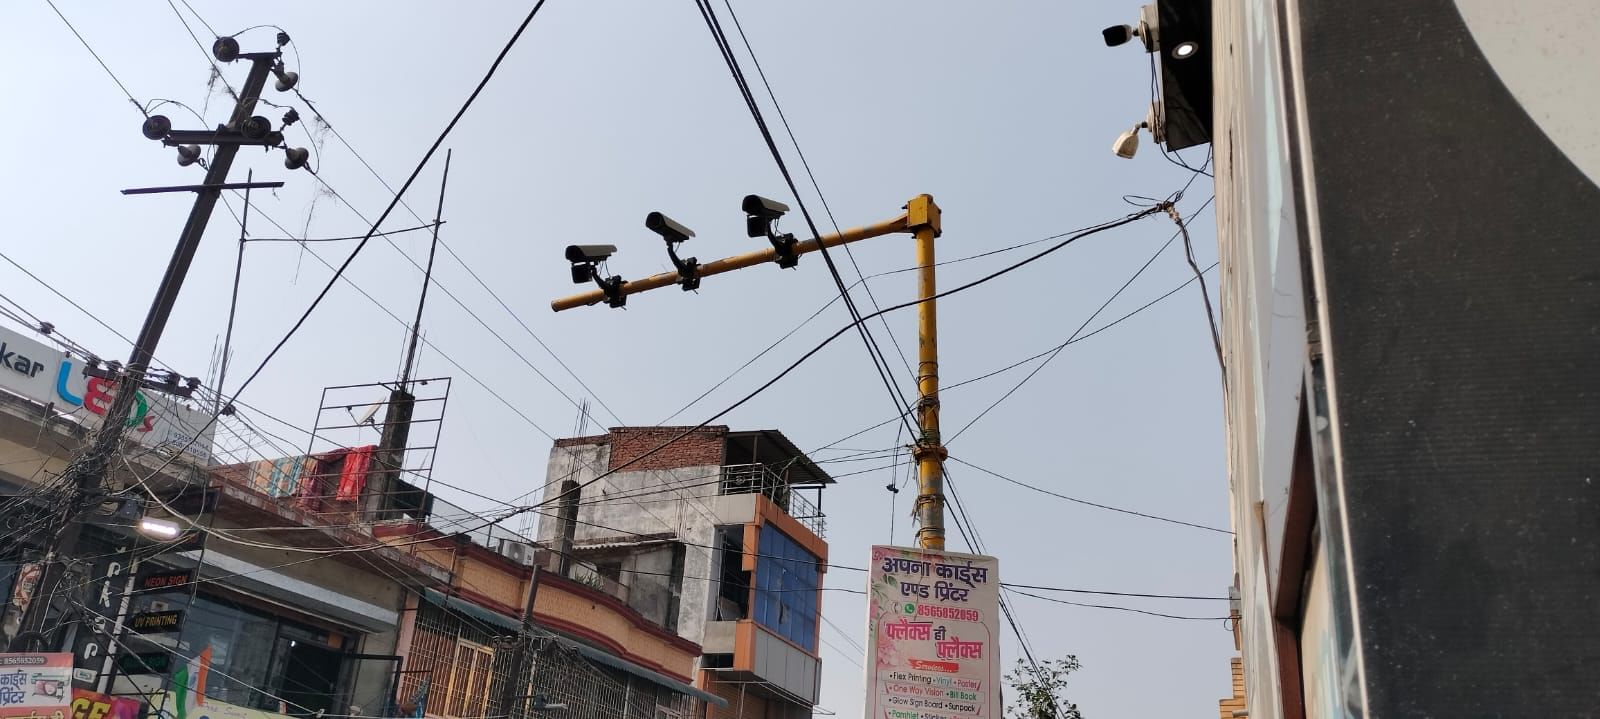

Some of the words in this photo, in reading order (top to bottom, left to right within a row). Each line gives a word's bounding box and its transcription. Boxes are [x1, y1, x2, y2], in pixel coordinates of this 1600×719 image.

[882, 557, 931, 576] अपना
[144, 577, 167, 587] NEON
[168, 575, 188, 586] SIGN
[900, 582, 930, 598] एण्ड
[934, 580, 969, 602] प्रिंटर
[134, 617, 145, 627] UV
[145, 614, 178, 627] PRINTING
[918, 604, 979, 621] 8565852059
[933, 625, 946, 640] ही
[893, 672, 906, 681] Flex
[908, 673, 931, 684] Printing
[935, 676, 952, 686] Vinyl
[957, 680, 977, 688] Poster
[893, 684, 907, 692] One
[910, 686, 922, 694] Way
[924, 687, 944, 696] Vision
[950, 690, 959, 699] Bill
[960, 692, 977, 701] Book
[892, 697, 909, 705] Glow
[910, 698, 923, 708] Sign
[924, 700, 943, 709] Board
[949, 703, 976, 713] Sunpack
